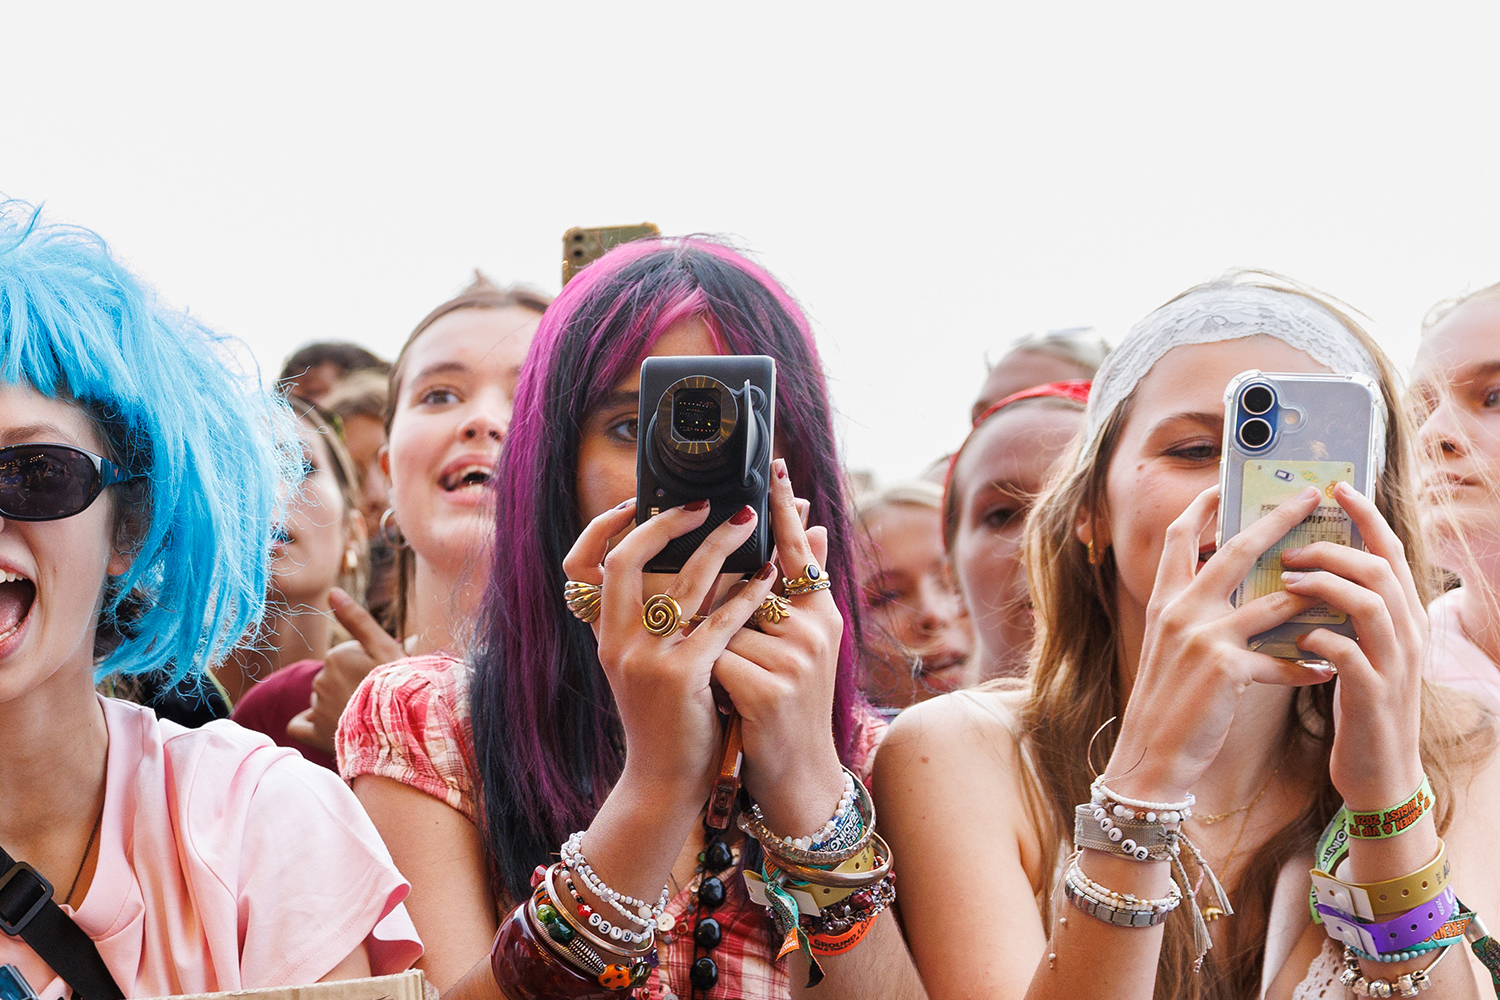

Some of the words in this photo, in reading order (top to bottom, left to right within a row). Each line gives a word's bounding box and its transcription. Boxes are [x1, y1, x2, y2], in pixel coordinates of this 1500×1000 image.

[1383, 797, 1418, 824] AUGUST
[1092, 807, 1148, 860] IVINE
[1361, 825, 1382, 838] VIP
[1381, 823, 1394, 835] &
[591, 913, 641, 942] RIES
[814, 934, 857, 949] GROUND
